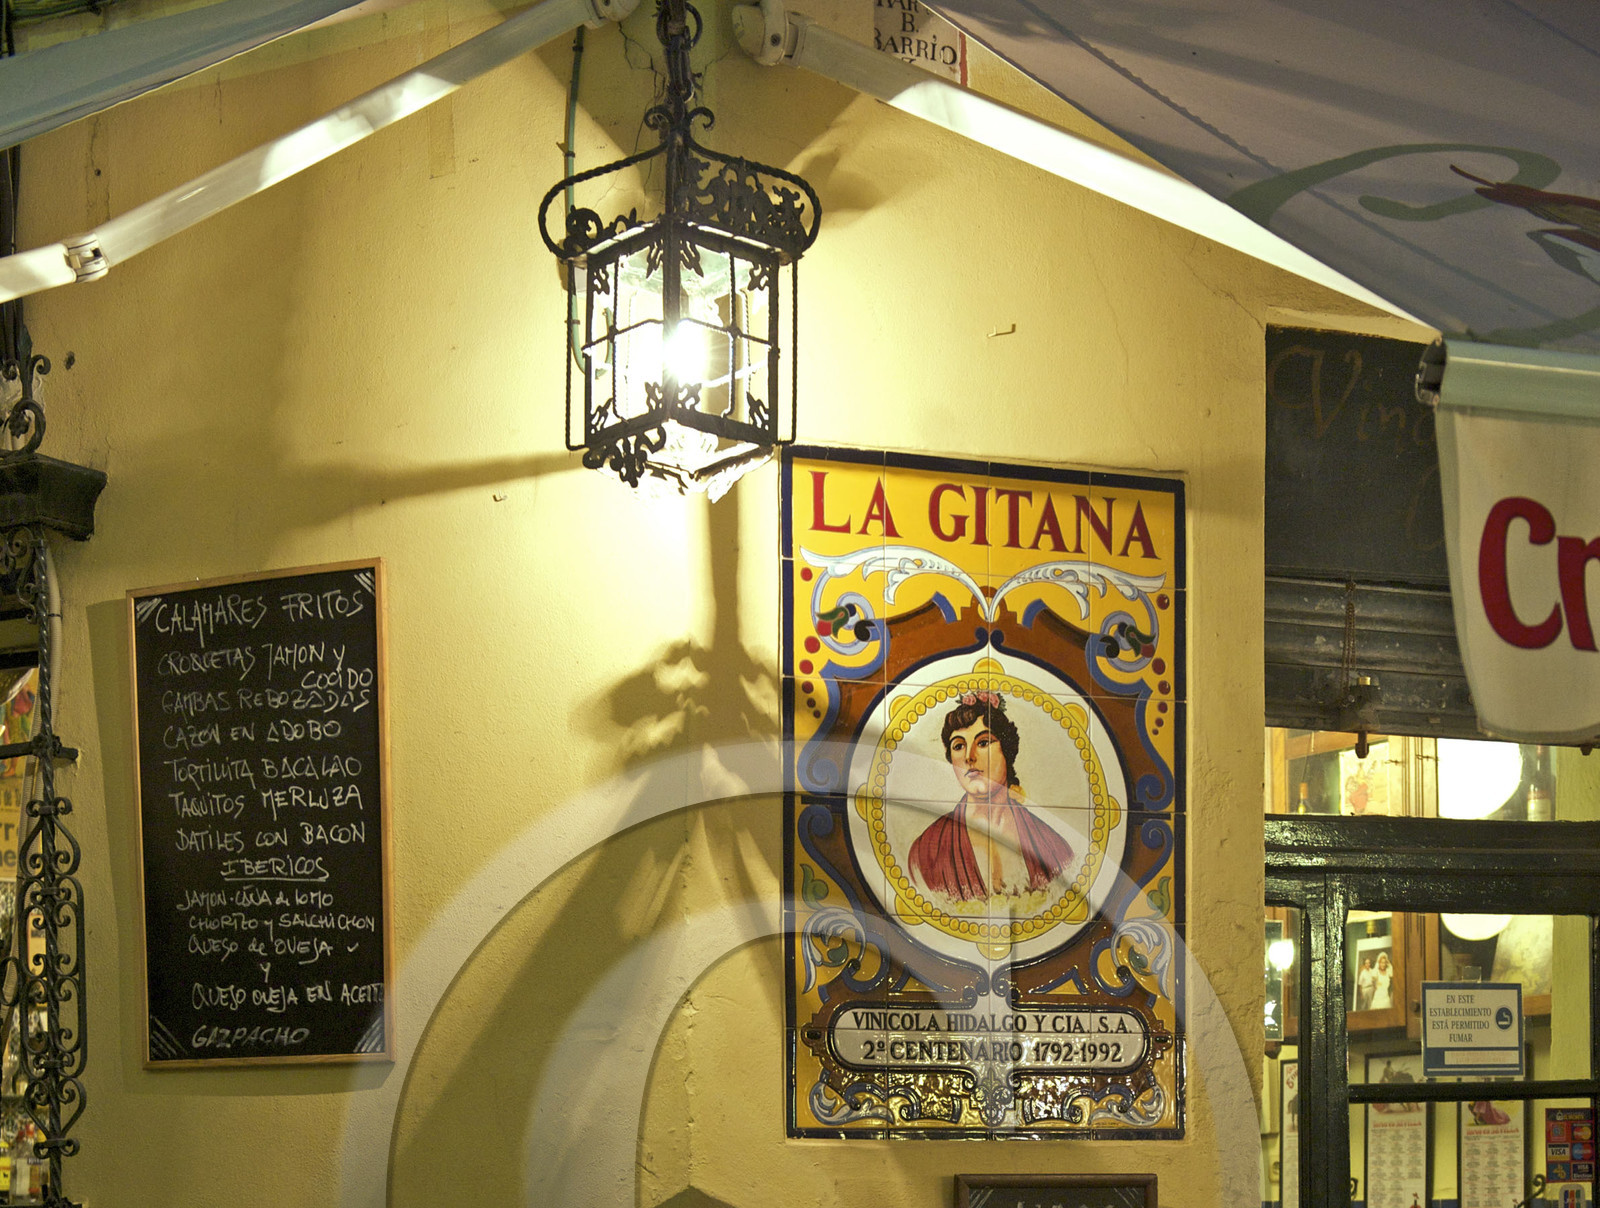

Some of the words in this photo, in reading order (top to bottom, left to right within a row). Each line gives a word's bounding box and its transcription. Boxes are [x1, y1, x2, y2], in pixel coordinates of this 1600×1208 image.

[902, 12, 919, 33] B.
[808, 470, 903, 538] LA
[928, 482, 1162, 560] GITANA
[155, 594, 268, 649] CALAMARES
[280, 589, 364, 622] FRITOS
[230, 722, 255, 742] EN
[267, 719, 342, 743] ADOBO
[262, 754, 363, 781] BACALAO
[168, 791, 246, 820] TAQUITOS
[261, 783, 364, 821] MERLUZA
[175, 824, 245, 854] DATILES
[255, 827, 289, 847] CON
[299, 820, 366, 846] BACON
[220, 854, 330, 880] IBERICOS
[188, 934, 239, 962] QUESO
[275, 936, 334, 965] OVEJA
[192, 982, 247, 1011] QUESO
[306, 979, 333, 1003] EN
[1446, 994, 1456, 1004] EN
[1458, 994, 1475, 1004] ESTE
[851, 1011, 939, 1032] VINICOLA
[947, 1013, 1027, 1033] HIDALGO
[1035, 1014, 1045, 1032] Y
[1098, 1015, 1133, 1034] S.A.
[1429, 1007, 1492, 1017] ESTABLECIMIENTO
[192, 1025, 310, 1048] GAZPACHO
[1432, 1019, 1449, 1030] ESTÁ
[1451, 1020, 1490, 1030] PERMITIDO
[1449, 1033, 1473, 1043] FUMAR
[890, 1041, 1024, 1062] CENTENARIO
[1034, 1041, 1123, 1063] 1792-1992
